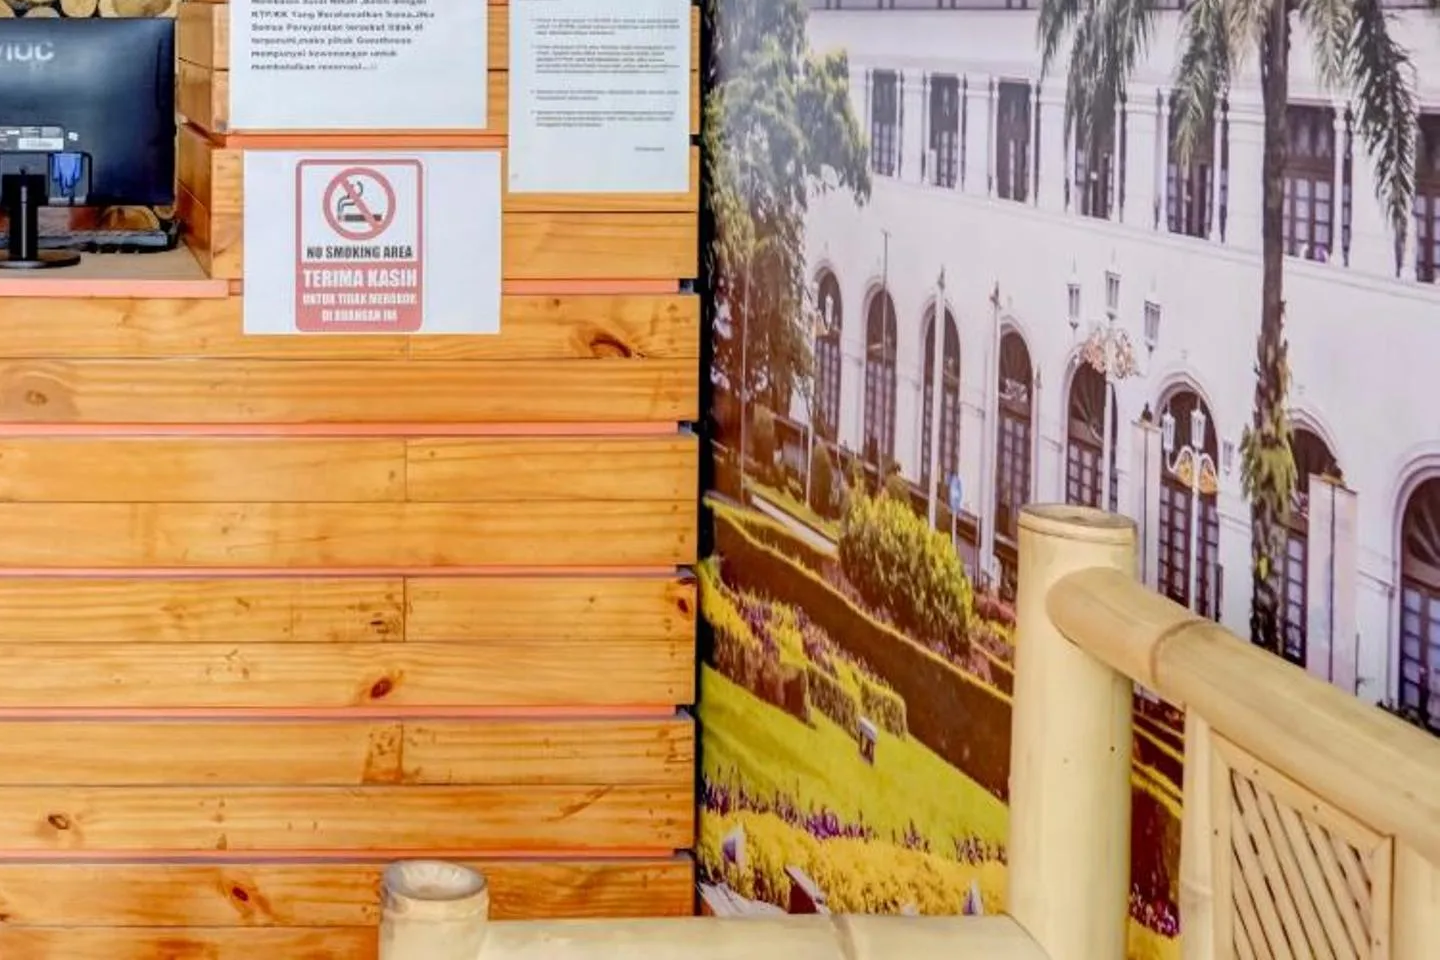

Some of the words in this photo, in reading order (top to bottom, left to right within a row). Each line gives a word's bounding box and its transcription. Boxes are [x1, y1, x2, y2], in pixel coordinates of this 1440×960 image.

[291, 10, 315, 19] Yang
[307, 246, 322, 259] NO
[325, 246, 381, 259] SMOKING
[383, 246, 413, 258] AREA
[303, 269, 364, 287] TERIMA
[368, 269, 417, 287] KASIH
